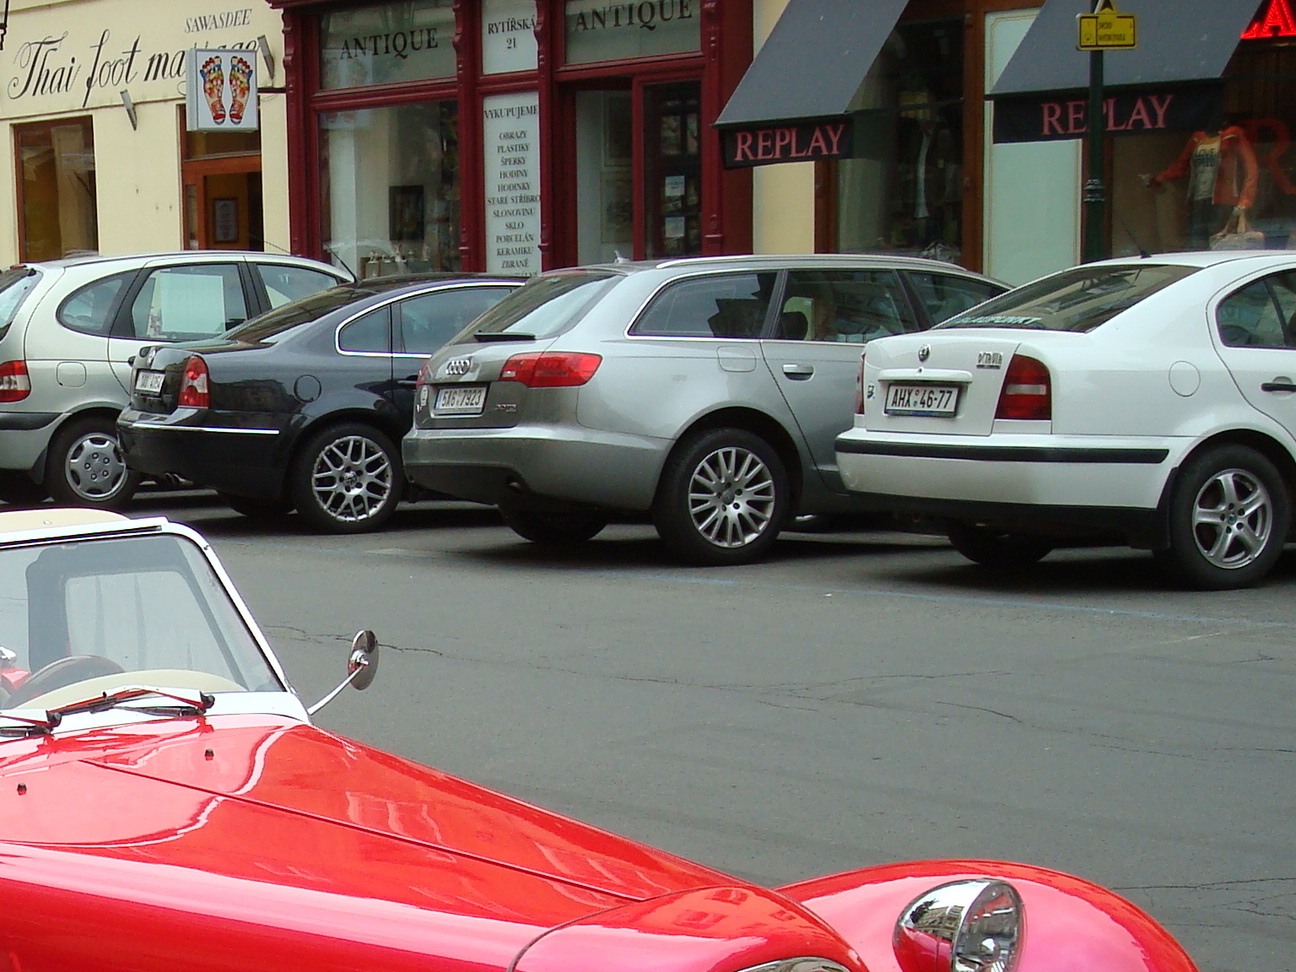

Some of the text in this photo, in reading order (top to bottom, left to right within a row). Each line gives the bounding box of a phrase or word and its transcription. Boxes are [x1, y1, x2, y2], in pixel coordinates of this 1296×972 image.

[185, 9, 252, 33] SAWASDEE
[574, 0, 692, 31] ANTIQUE
[340, 28, 438, 59] ANTIQUE
[506, 38, 517, 49] 21
[7, 31, 81, 100] Thai
[82, 29, 142, 108] foot
[484, 105, 538, 119] VYKUPUJEME
[1041, 95, 1173, 136] RELAY
[734, 124, 846, 162] REPLAY
[493, 207, 536, 218] SLONOVINU
[505, 221, 524, 230] SKLO
[496, 232, 534, 243] PORCELÁN
[891, 388, 953, 409] AHX 46-77
